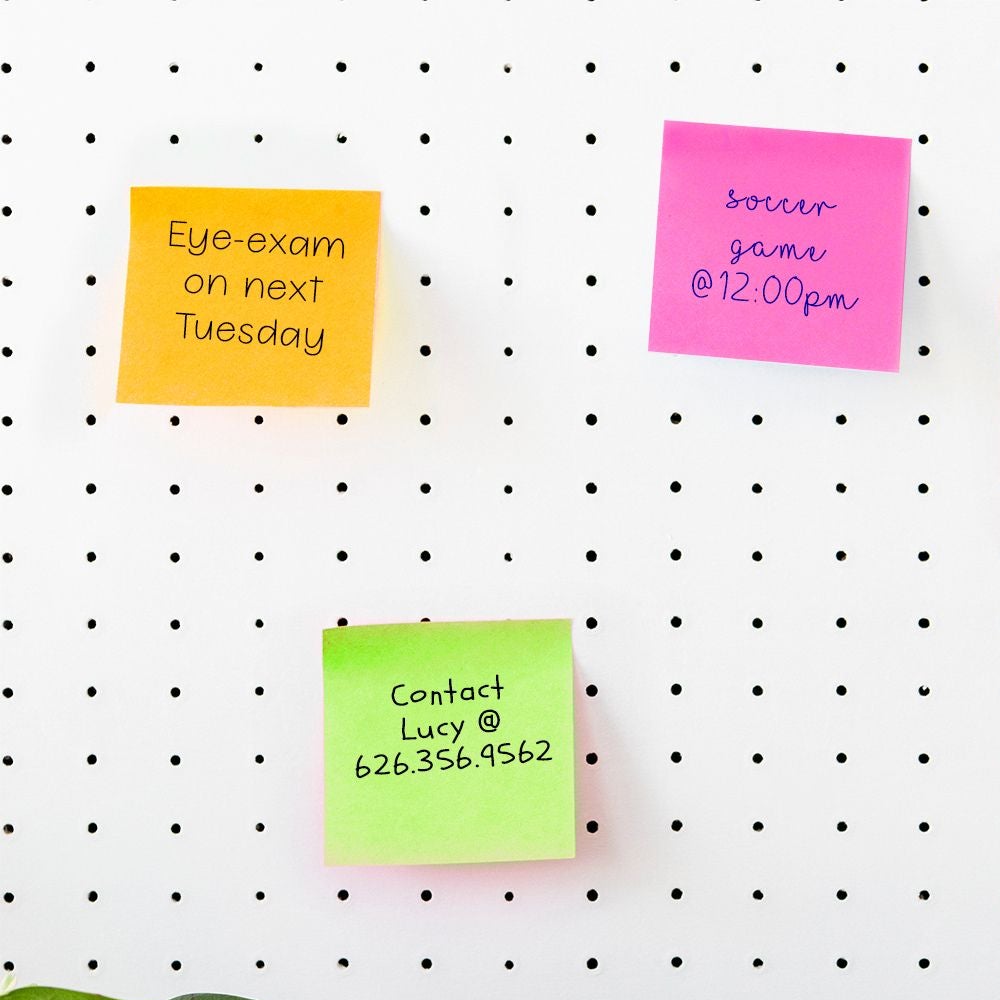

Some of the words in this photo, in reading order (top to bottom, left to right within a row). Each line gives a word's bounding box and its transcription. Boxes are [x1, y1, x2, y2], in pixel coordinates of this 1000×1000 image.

[725, 188, 838, 217] soccer
[168, 220, 345, 260] Eye-exam
[730, 238, 827, 265] game
[184, 273, 228, 296] on
[244, 275, 324, 304] next
[691, 269, 860, 317] @12:00pm
[175, 311, 325, 357] Tuesday
[390, 673, 505, 707] Contact
[401, 716, 465, 744] Lucy
[477, 708, 501, 733] @
[354, 739, 553, 779] 626.356.9562
